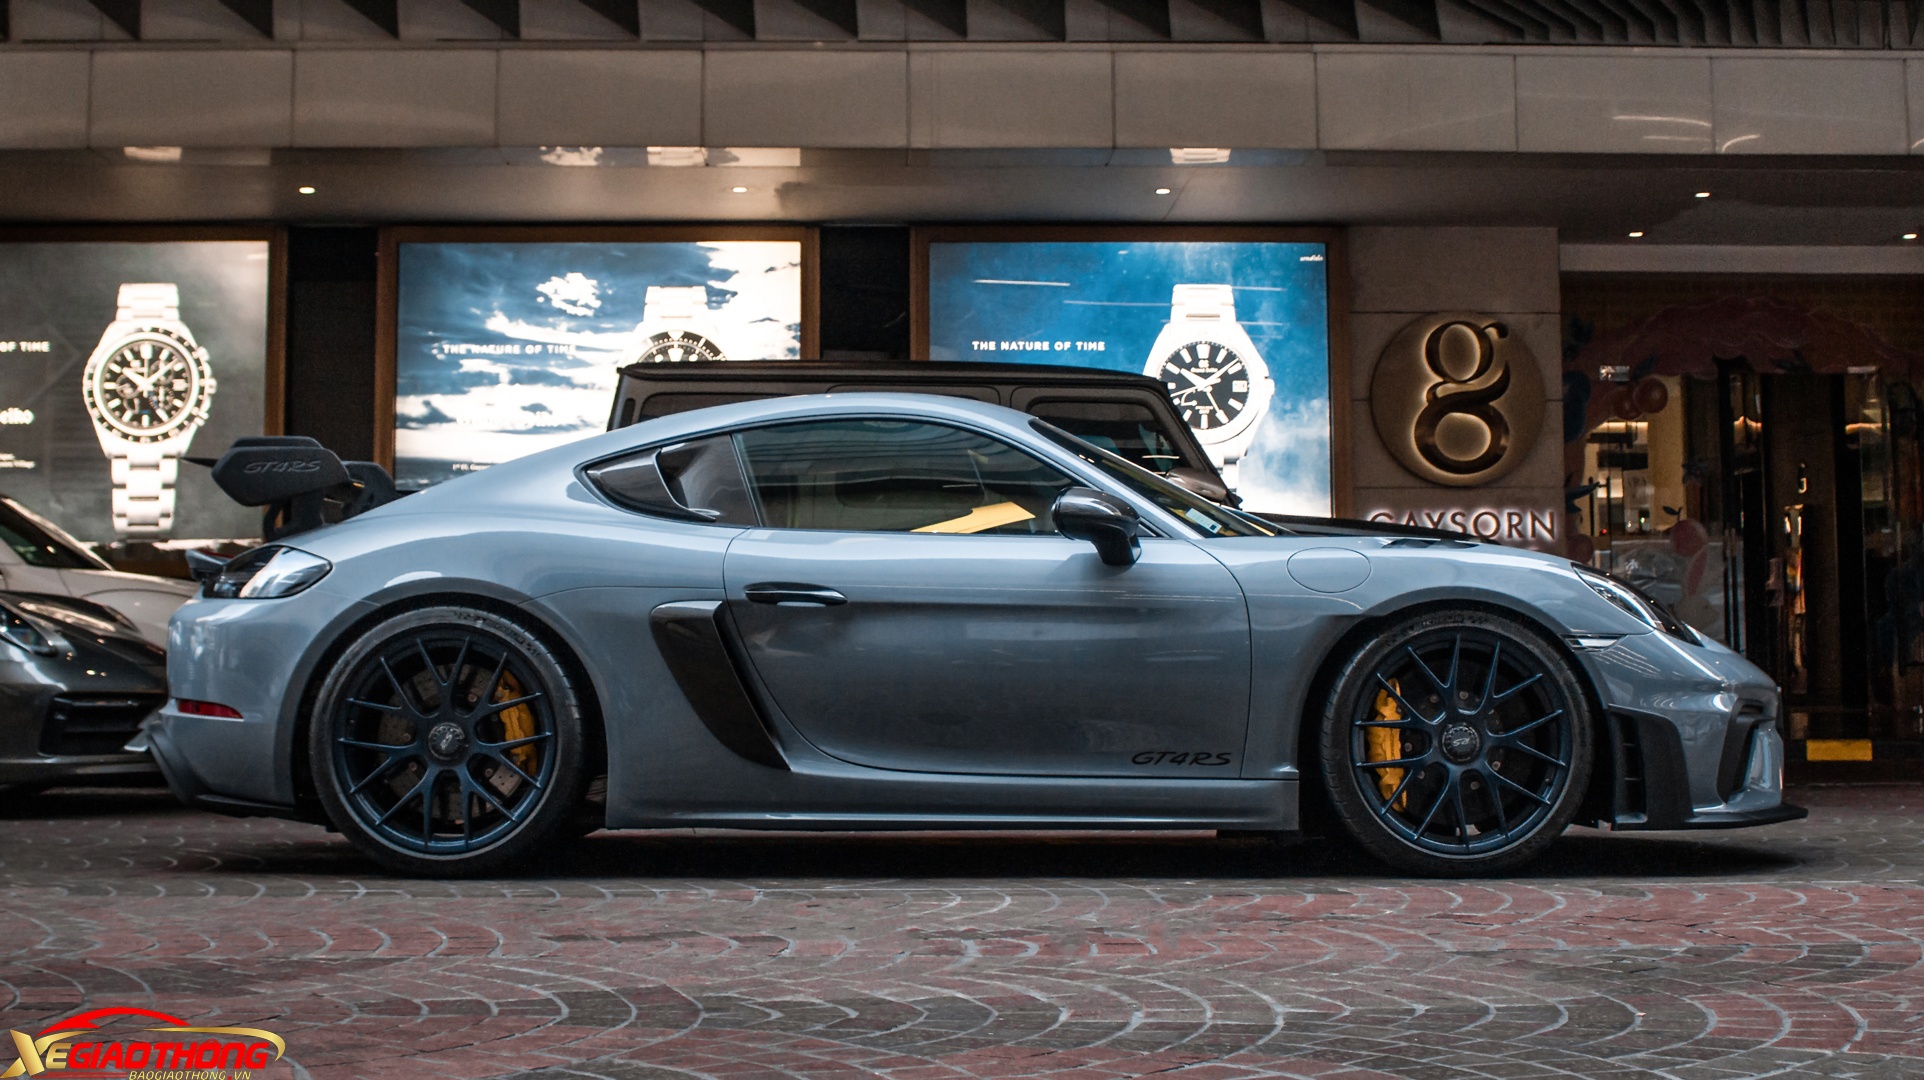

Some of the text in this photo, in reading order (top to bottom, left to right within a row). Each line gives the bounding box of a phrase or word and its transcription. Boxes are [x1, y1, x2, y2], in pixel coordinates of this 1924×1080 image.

[0, 341, 50, 352] OF TIME
[442, 344, 576, 355] THE NATURE OF TIME
[972, 341, 1106, 351] THE NATURE OF TIME
[243, 460, 321, 474] GT4RS
[1131, 751, 1232, 766] GT4RS
